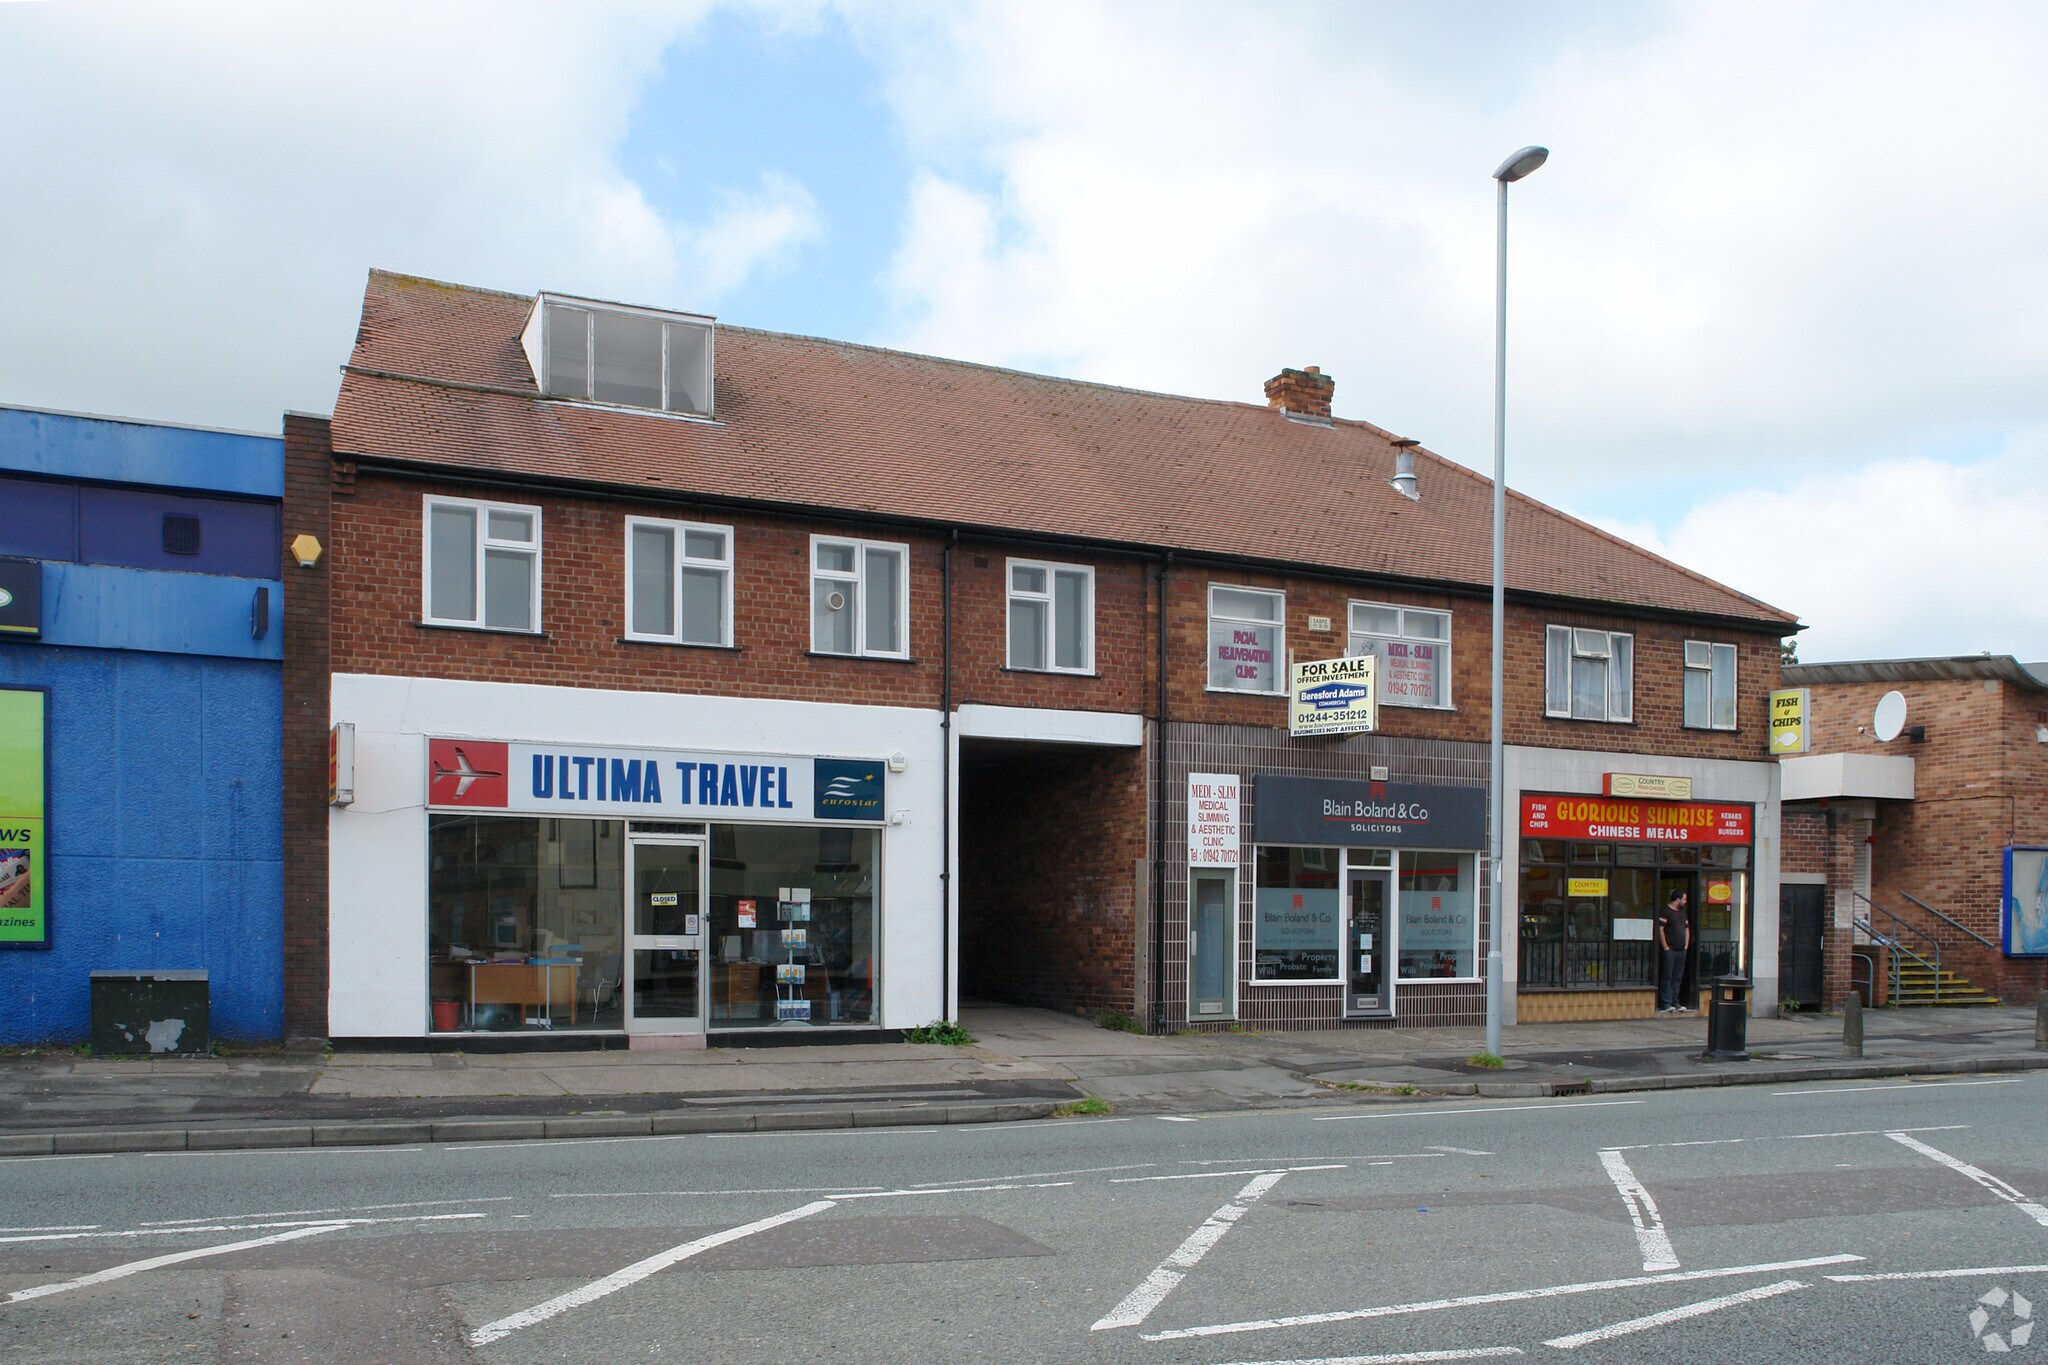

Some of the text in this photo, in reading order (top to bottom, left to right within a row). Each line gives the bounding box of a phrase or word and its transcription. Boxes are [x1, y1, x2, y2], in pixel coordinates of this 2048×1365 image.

[1233, 630, 1258, 645] FACIAL
[1219, 646, 1271, 664] REJUVENATION
[1388, 643, 1408, 657] MEDI
[1414, 645, 1433, 659] SLIM
[1235, 665, 1257, 679] CLINIC
[1302, 660, 1365, 676] FOR SALE
[1297, 671, 1370, 684] OFFICE INVESTMENT
[1301, 688, 1365, 701] Beresford Adams
[1388, 682, 1432, 697] 01942 701721
[1776, 697, 1799, 708] FISH
[1298, 710, 1367, 723] 01244-351212
[1772, 717, 1802, 727] CHIPS
[532, 754, 793, 808] ULTIMA TRAVEL
[1192, 784, 1211, 798] MEDI
[1218, 785, 1236, 799] SLIM
[822, 797, 879, 807] eurostar
[1199, 801, 1228, 811] MEDICAL
[1323, 799, 1428, 820] Blain Boland & Co
[1556, 801, 1714, 826] GLORIOUS SUNRISE
[1721, 812, 1742, 820] KEBABS
[1198, 812, 1230, 822] SLIMMING
[1191, 824, 1236, 835] & AESTHETIC
[1351, 824, 1402, 833] SOLICITORS
[1588, 824, 1688, 839] CHINESE MEALS
[1718, 828, 1744, 836] BURGERS
[1202, 837, 1224, 846] CLINIC
[1203, 849, 1219, 862] 01942
[1221, 849, 1239, 863] 701721
[1265, 912, 1331, 923] Blain Boland & Co
[1406, 914, 1422, 923] Blain
[1424, 914, 1447, 923] Boland
[1456, 914, 1467, 924] Co
[1302, 952, 1336, 963] Property
[1280, 963, 1307, 971] Probate
